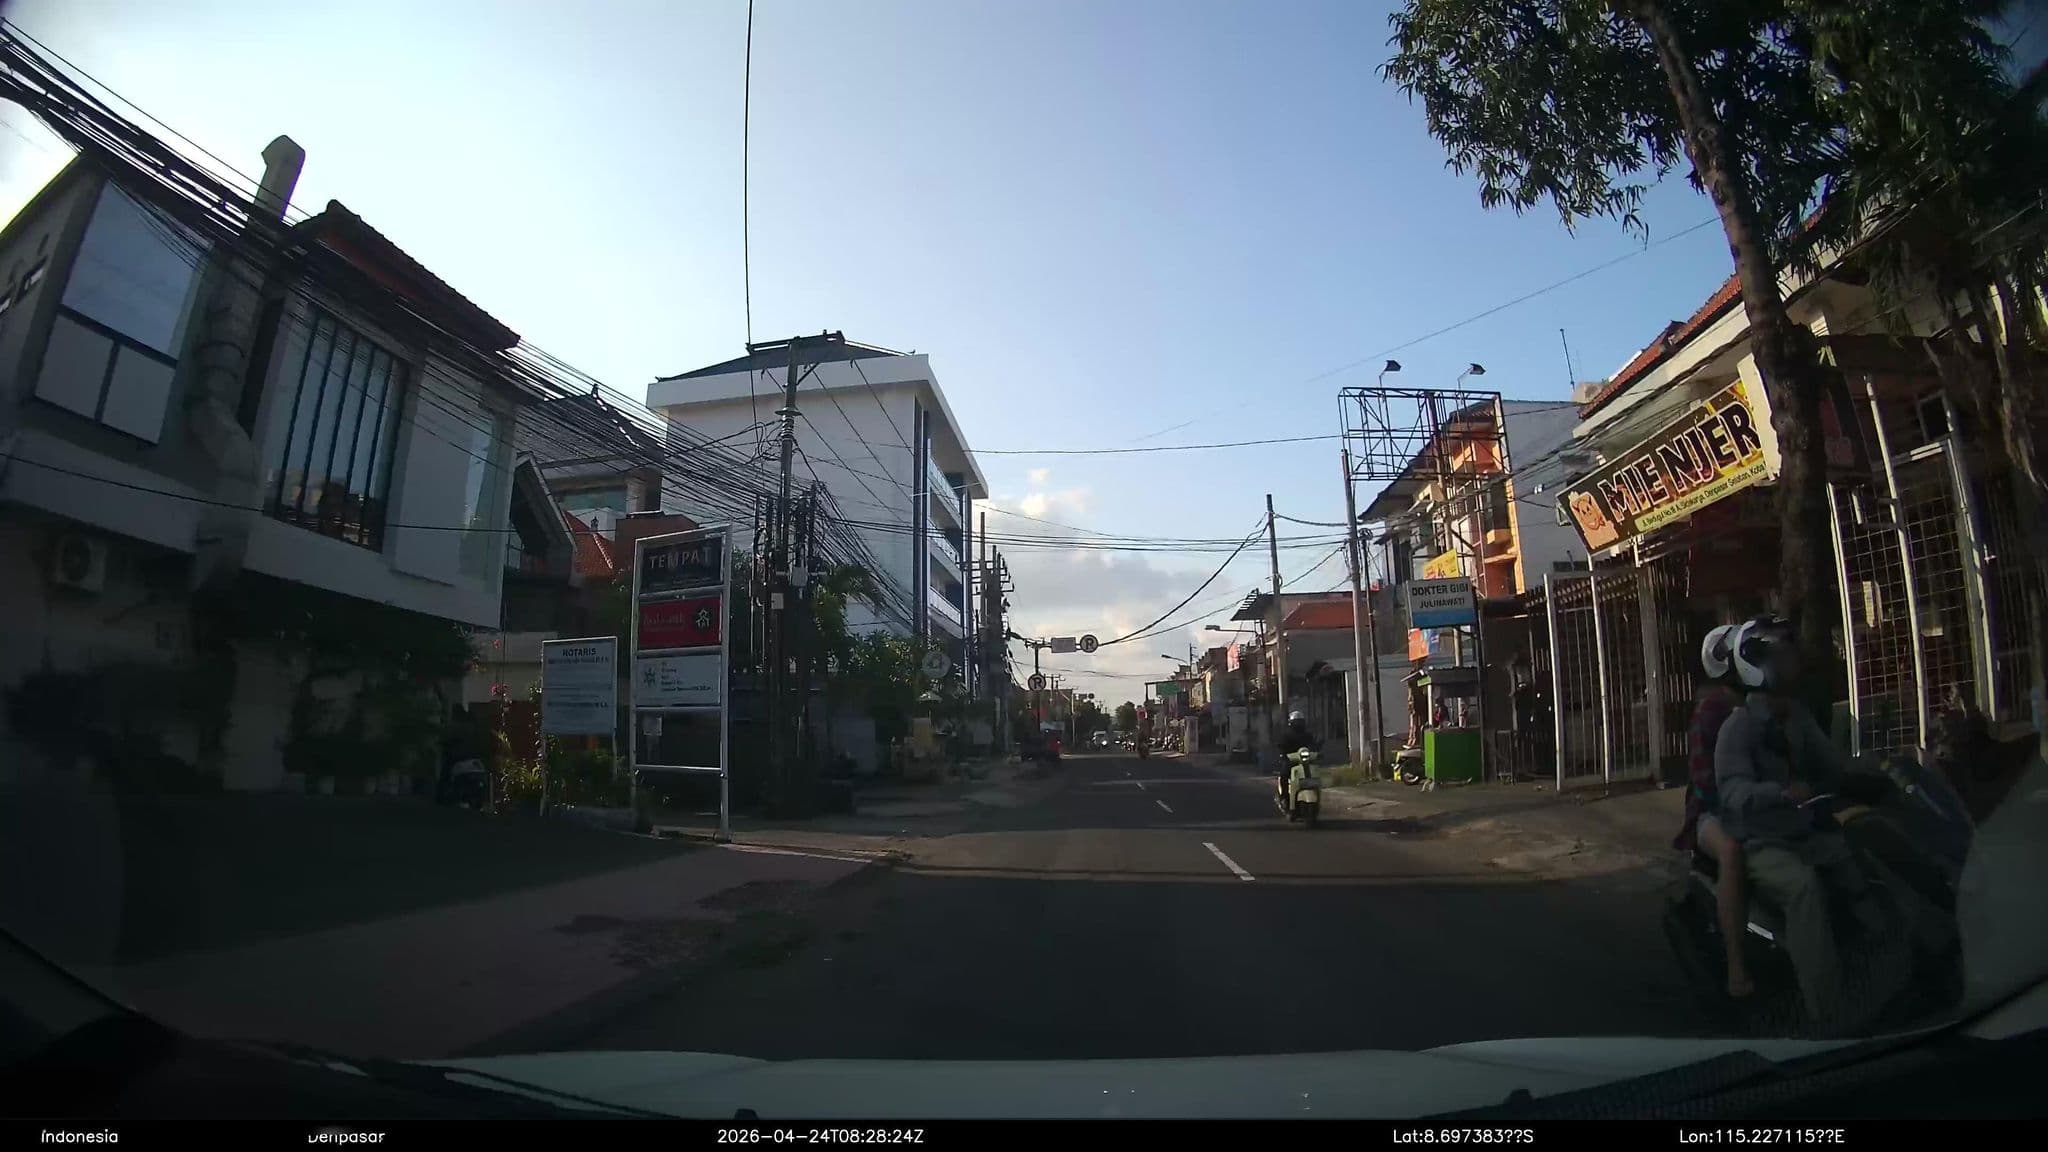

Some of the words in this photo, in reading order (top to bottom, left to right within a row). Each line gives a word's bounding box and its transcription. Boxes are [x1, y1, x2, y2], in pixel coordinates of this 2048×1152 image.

[1597, 454, 1670, 522] MIE
[1656, 401, 1761, 494] NJER
[650, 547, 712, 569] TEMPAT
[1412, 585, 1448, 596] DOKTER
[562, 648, 597, 657] NOTARIS
